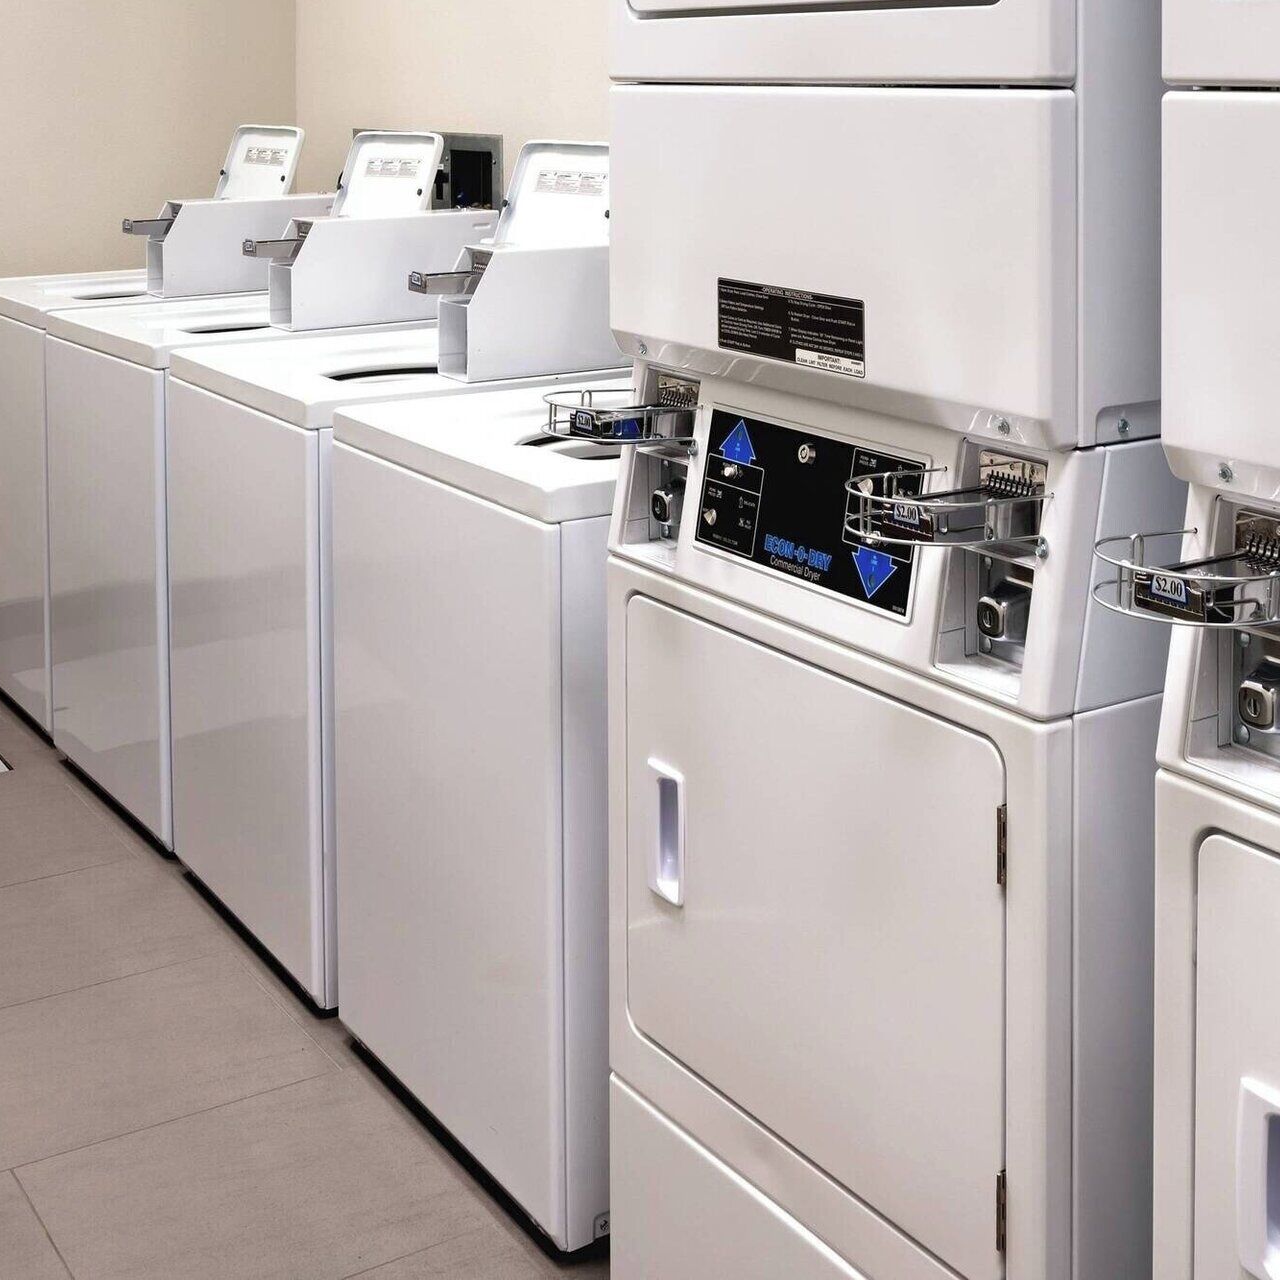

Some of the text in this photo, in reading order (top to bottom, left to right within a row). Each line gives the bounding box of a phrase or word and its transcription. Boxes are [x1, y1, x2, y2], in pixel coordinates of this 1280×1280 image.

[895, 505, 917, 520] $2.00
[804, 567, 821, 581] Dryer
[1155, 576, 1183, 597] $2.00
